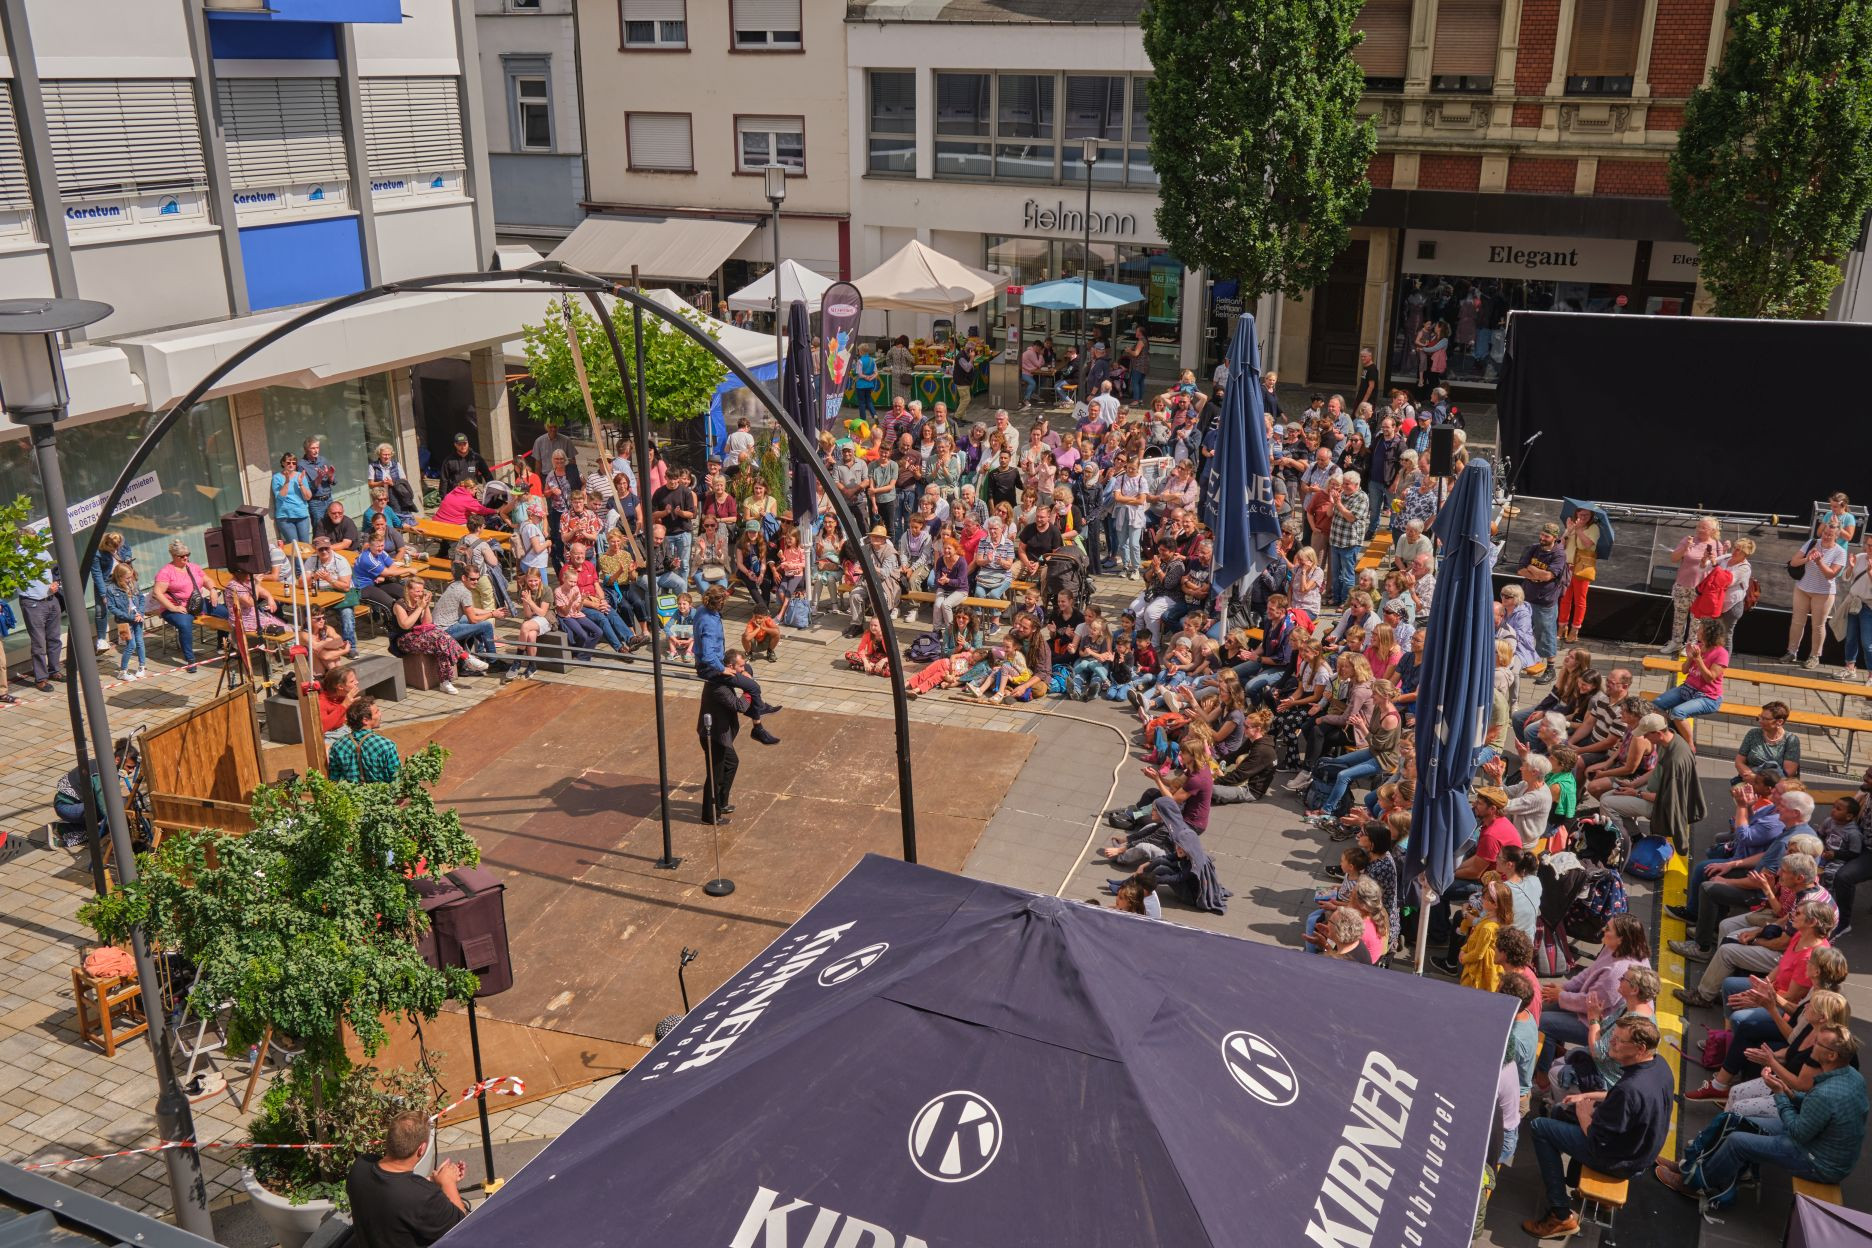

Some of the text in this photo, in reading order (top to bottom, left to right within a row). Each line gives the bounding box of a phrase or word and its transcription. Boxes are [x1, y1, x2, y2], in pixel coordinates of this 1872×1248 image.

[66, 205, 120, 219] Caratum
[233, 191, 277, 204] Caratum
[1024, 199, 1136, 235] fielmann
[1488, 245, 1579, 268] Elegant
[68, 496, 109, 518] werberäum
[673, 919, 858, 1074] KIRNER
[1304, 1050, 1419, 1248] KIRNER
[1401, 1092, 1456, 1248] atbrauerei
